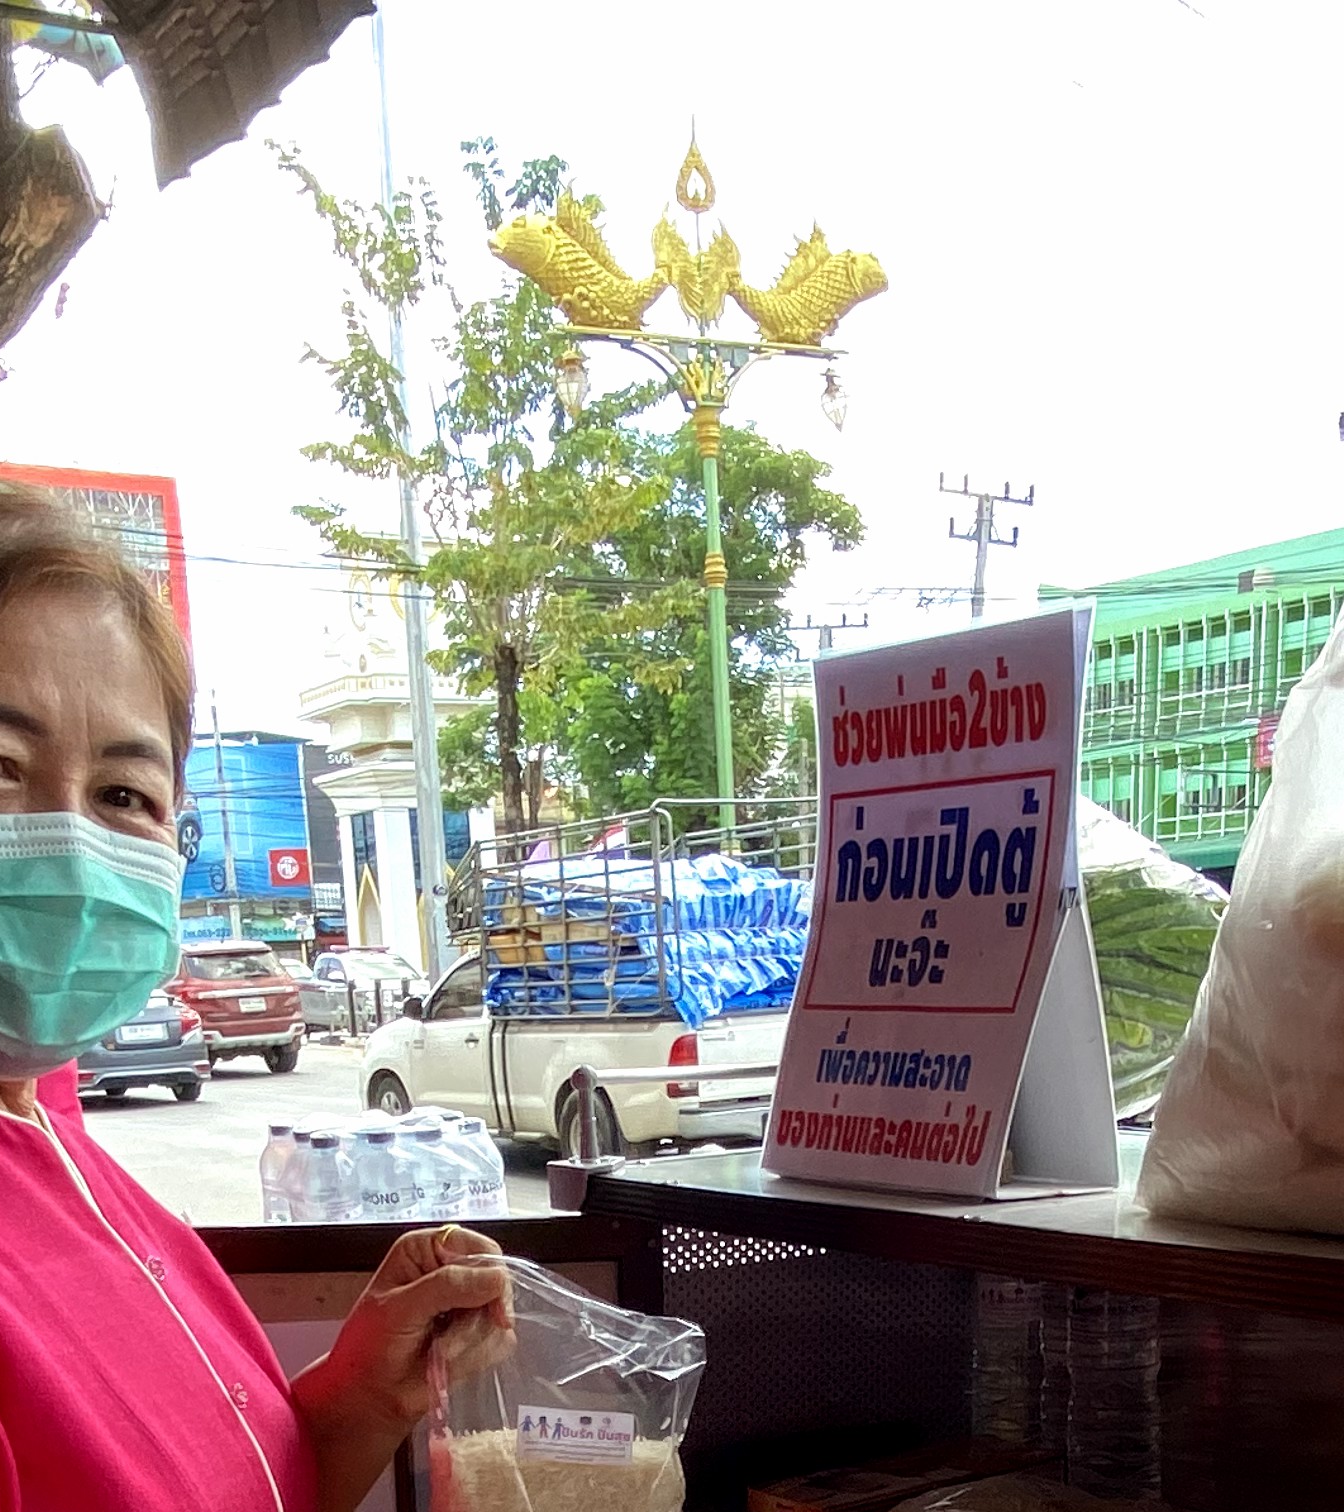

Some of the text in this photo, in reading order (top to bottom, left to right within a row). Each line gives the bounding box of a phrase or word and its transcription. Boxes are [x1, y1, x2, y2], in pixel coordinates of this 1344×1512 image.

[832, 656, 1047, 768] ช่วยพ่นมือ2ข้าง
[835, 787, 1040, 928] ก่อนเปิดตู้
[869, 908, 950, 988] นะจ๊ะ
[816, 1016, 972, 1092] เพื่อความสะอาด
[776, 1093, 992, 1167] ของท่านและคนต่อไป
